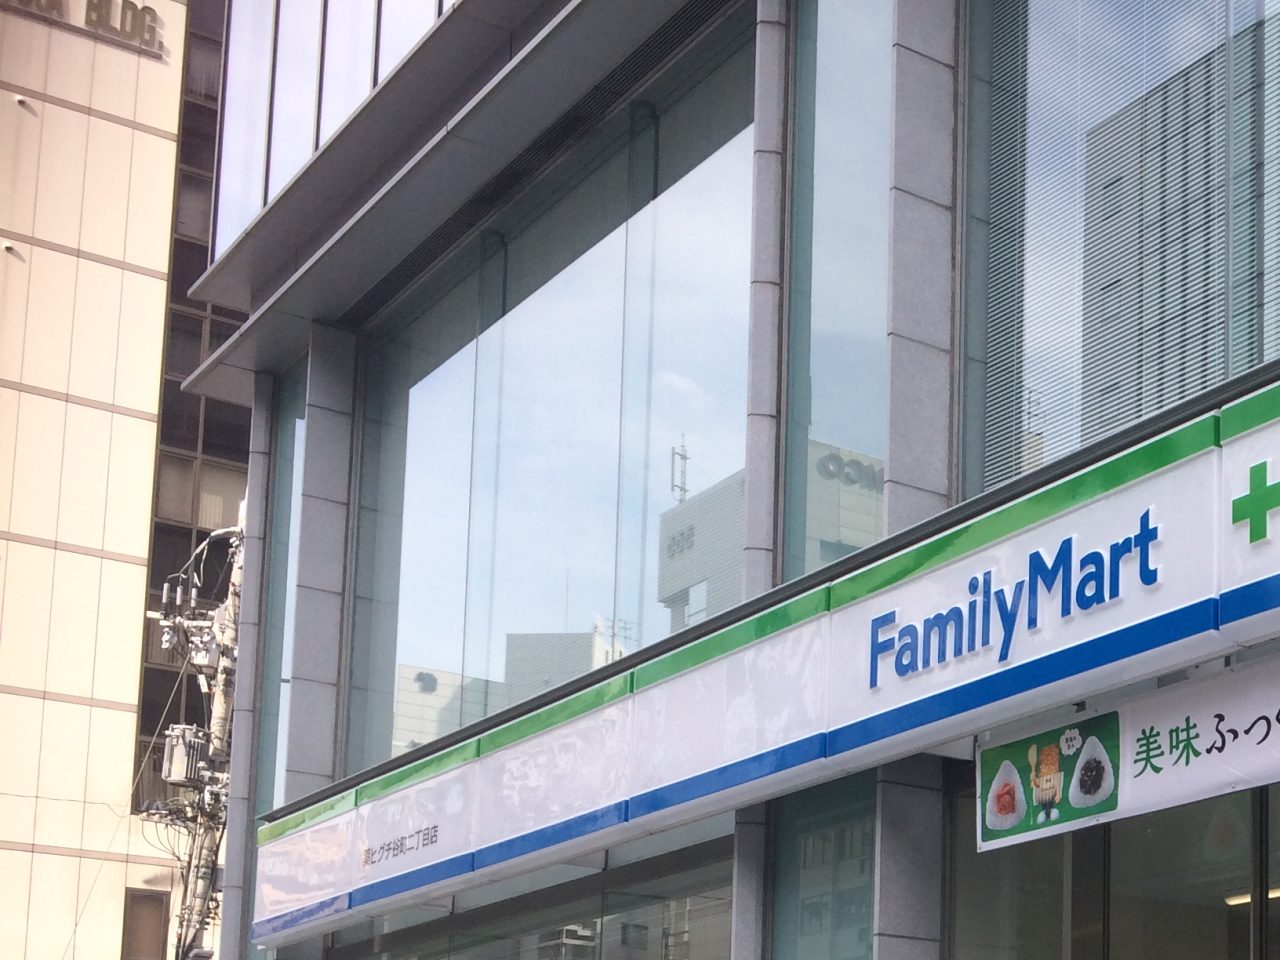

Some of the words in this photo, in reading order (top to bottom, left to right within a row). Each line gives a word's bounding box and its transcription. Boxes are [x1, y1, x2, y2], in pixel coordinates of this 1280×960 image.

[84, 0, 164, 50] BLDG.
[868, 508, 1161, 689] FamilyMart
[362, 825, 439, 867] 薬ヒグチ谷町二丁目店
